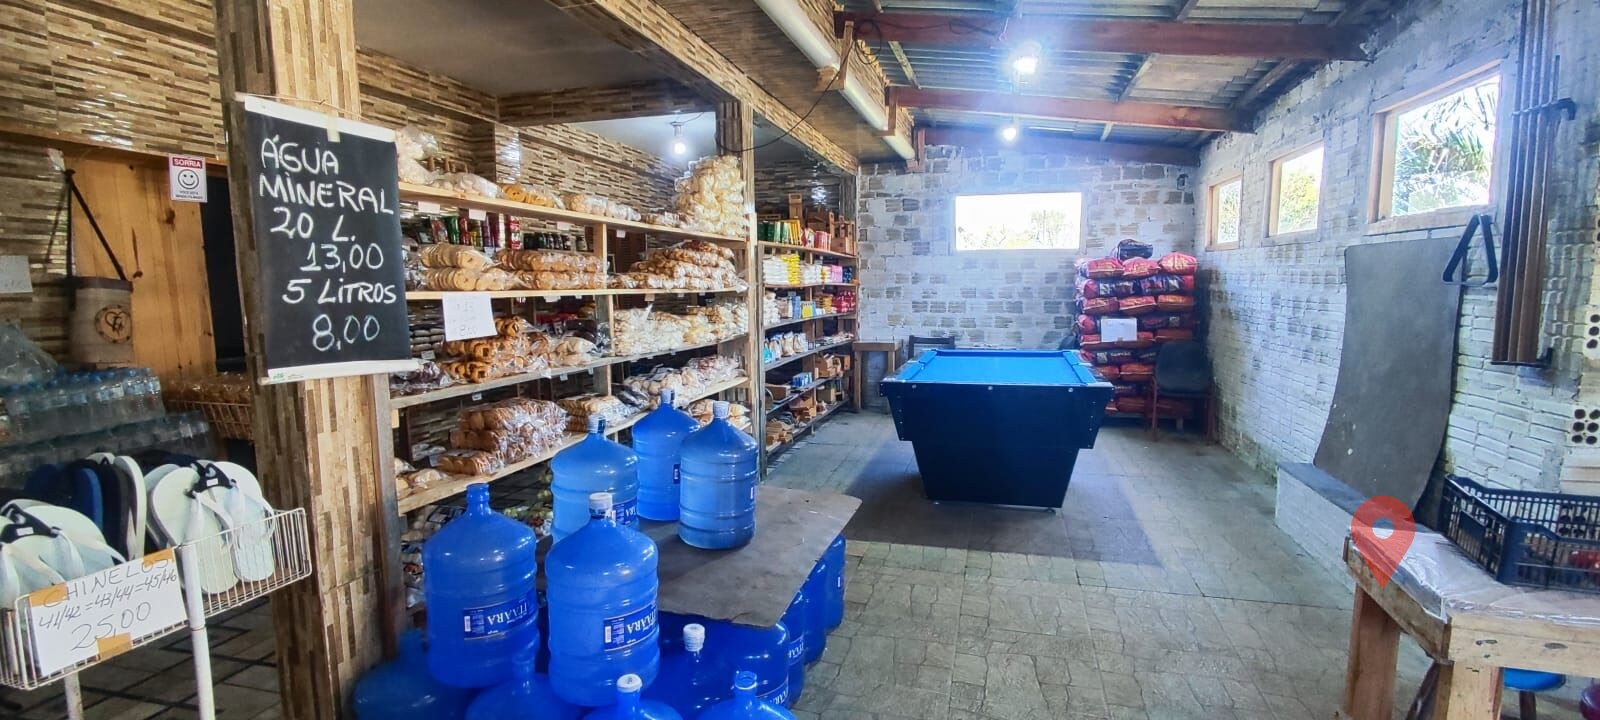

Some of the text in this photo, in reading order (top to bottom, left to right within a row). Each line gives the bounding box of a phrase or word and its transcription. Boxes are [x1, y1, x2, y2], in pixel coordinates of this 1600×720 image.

[173, 158, 202, 168] SORRIA
[260, 134, 339, 175] ÁGUA
[259, 171, 394, 215] MINERAL
[270, 206, 356, 242] 20 L.
[300, 242, 384, 273] 13,00
[282, 278, 397, 304] 5 LITROS
[312, 314, 380, 351] 8,00
[44, 558, 169, 607] CHINELOS
